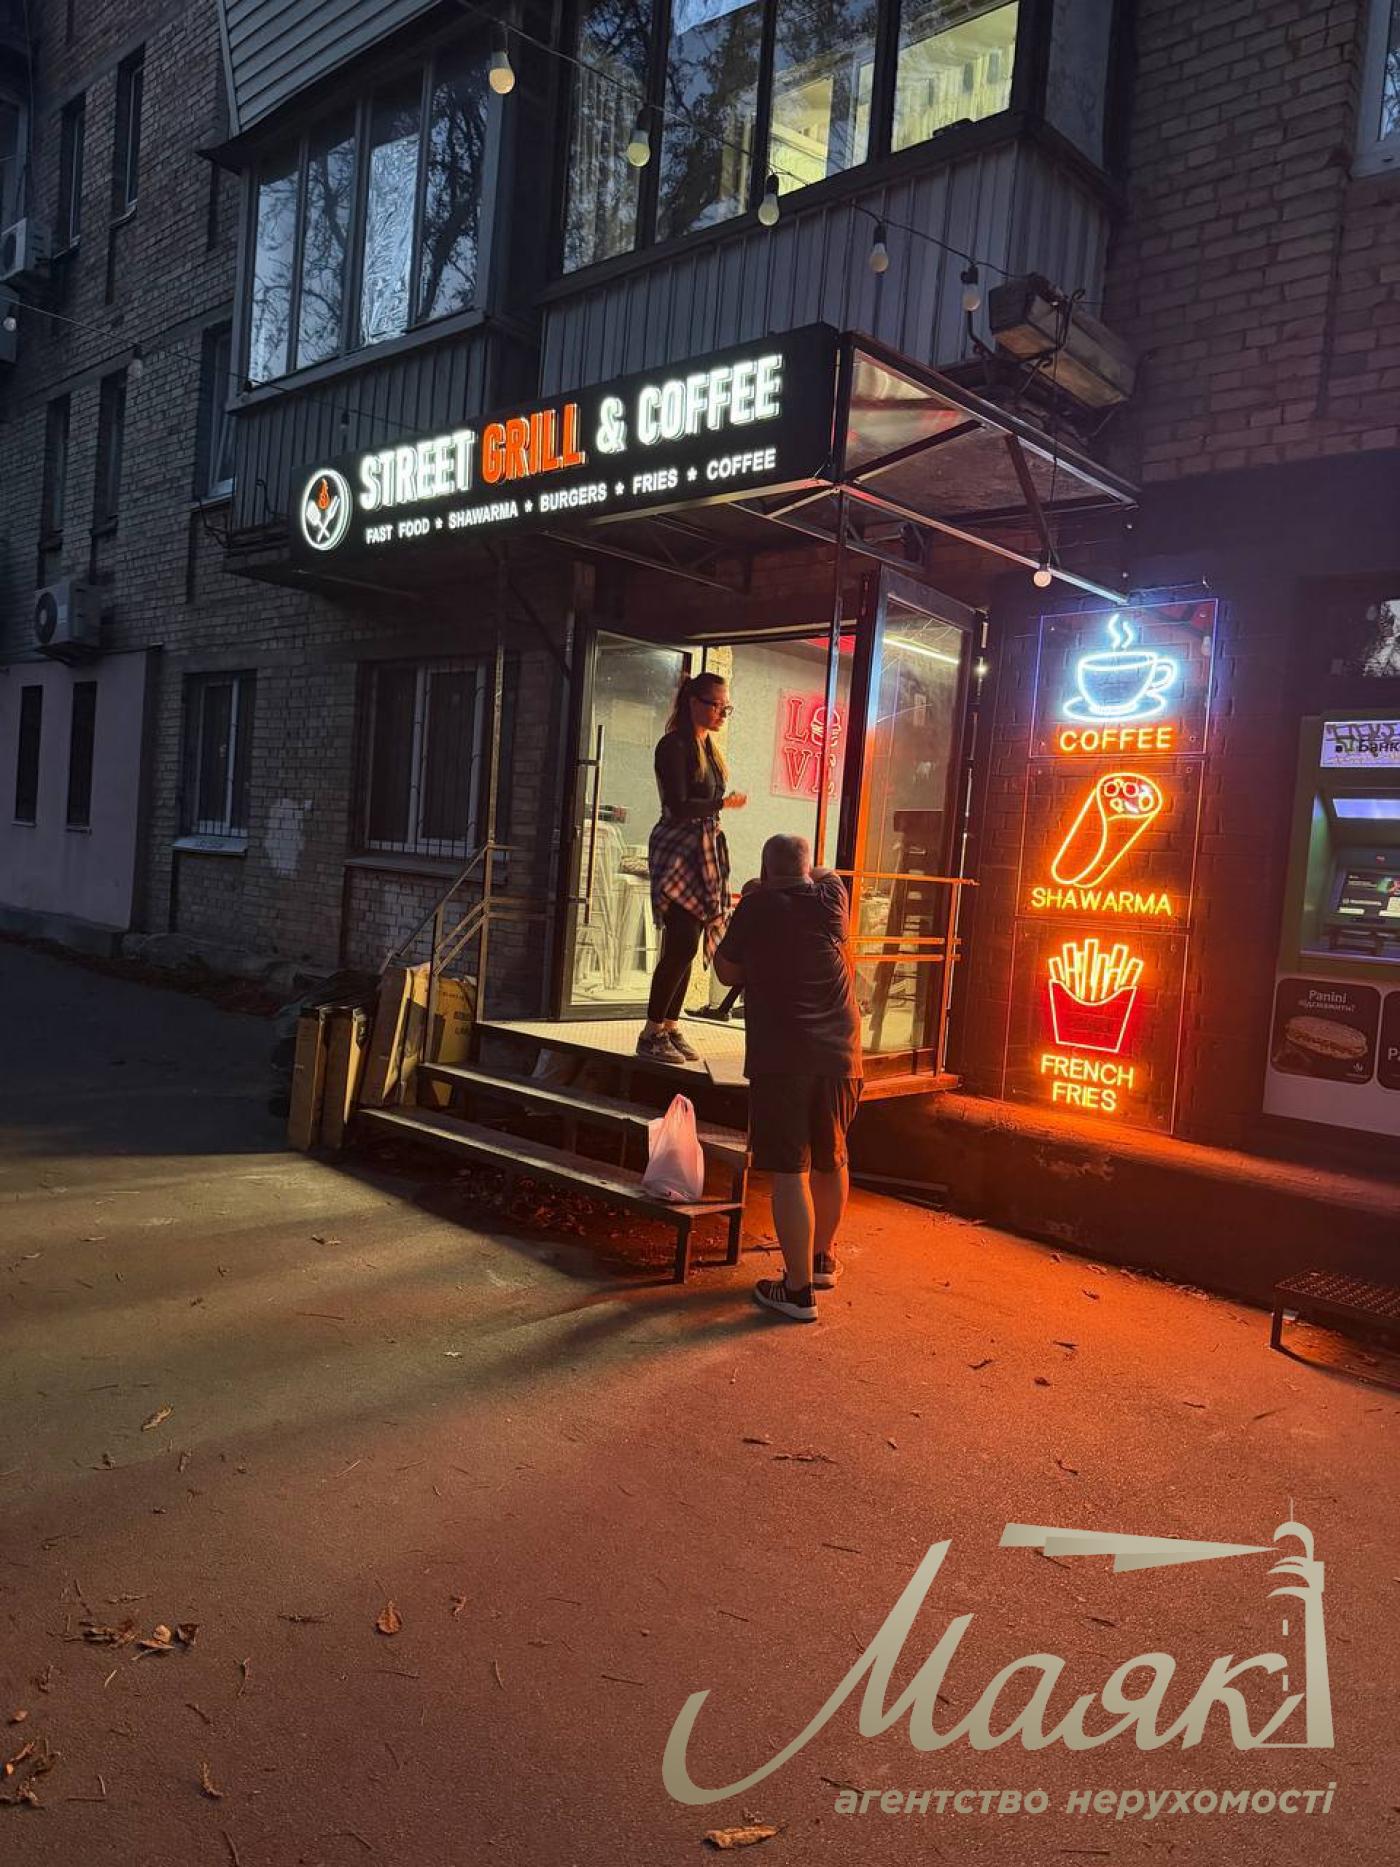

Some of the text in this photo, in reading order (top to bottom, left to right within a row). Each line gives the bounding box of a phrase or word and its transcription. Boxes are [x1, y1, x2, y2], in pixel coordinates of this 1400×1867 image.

[359, 354, 783, 509] STREET GRILL & COFFEE
[366, 448, 777, 544] FAST FOOD SHAWARMA BURGERS FRIES COFFEE
[1060, 727, 1173, 751] COFFEE
[1031, 887, 1172, 916] SHAWARMA
[1308, 990, 1347, 1003] Panini
[1041, 1054, 1134, 1089] FRENCH
[1052, 1081, 1117, 1112] FRIES
